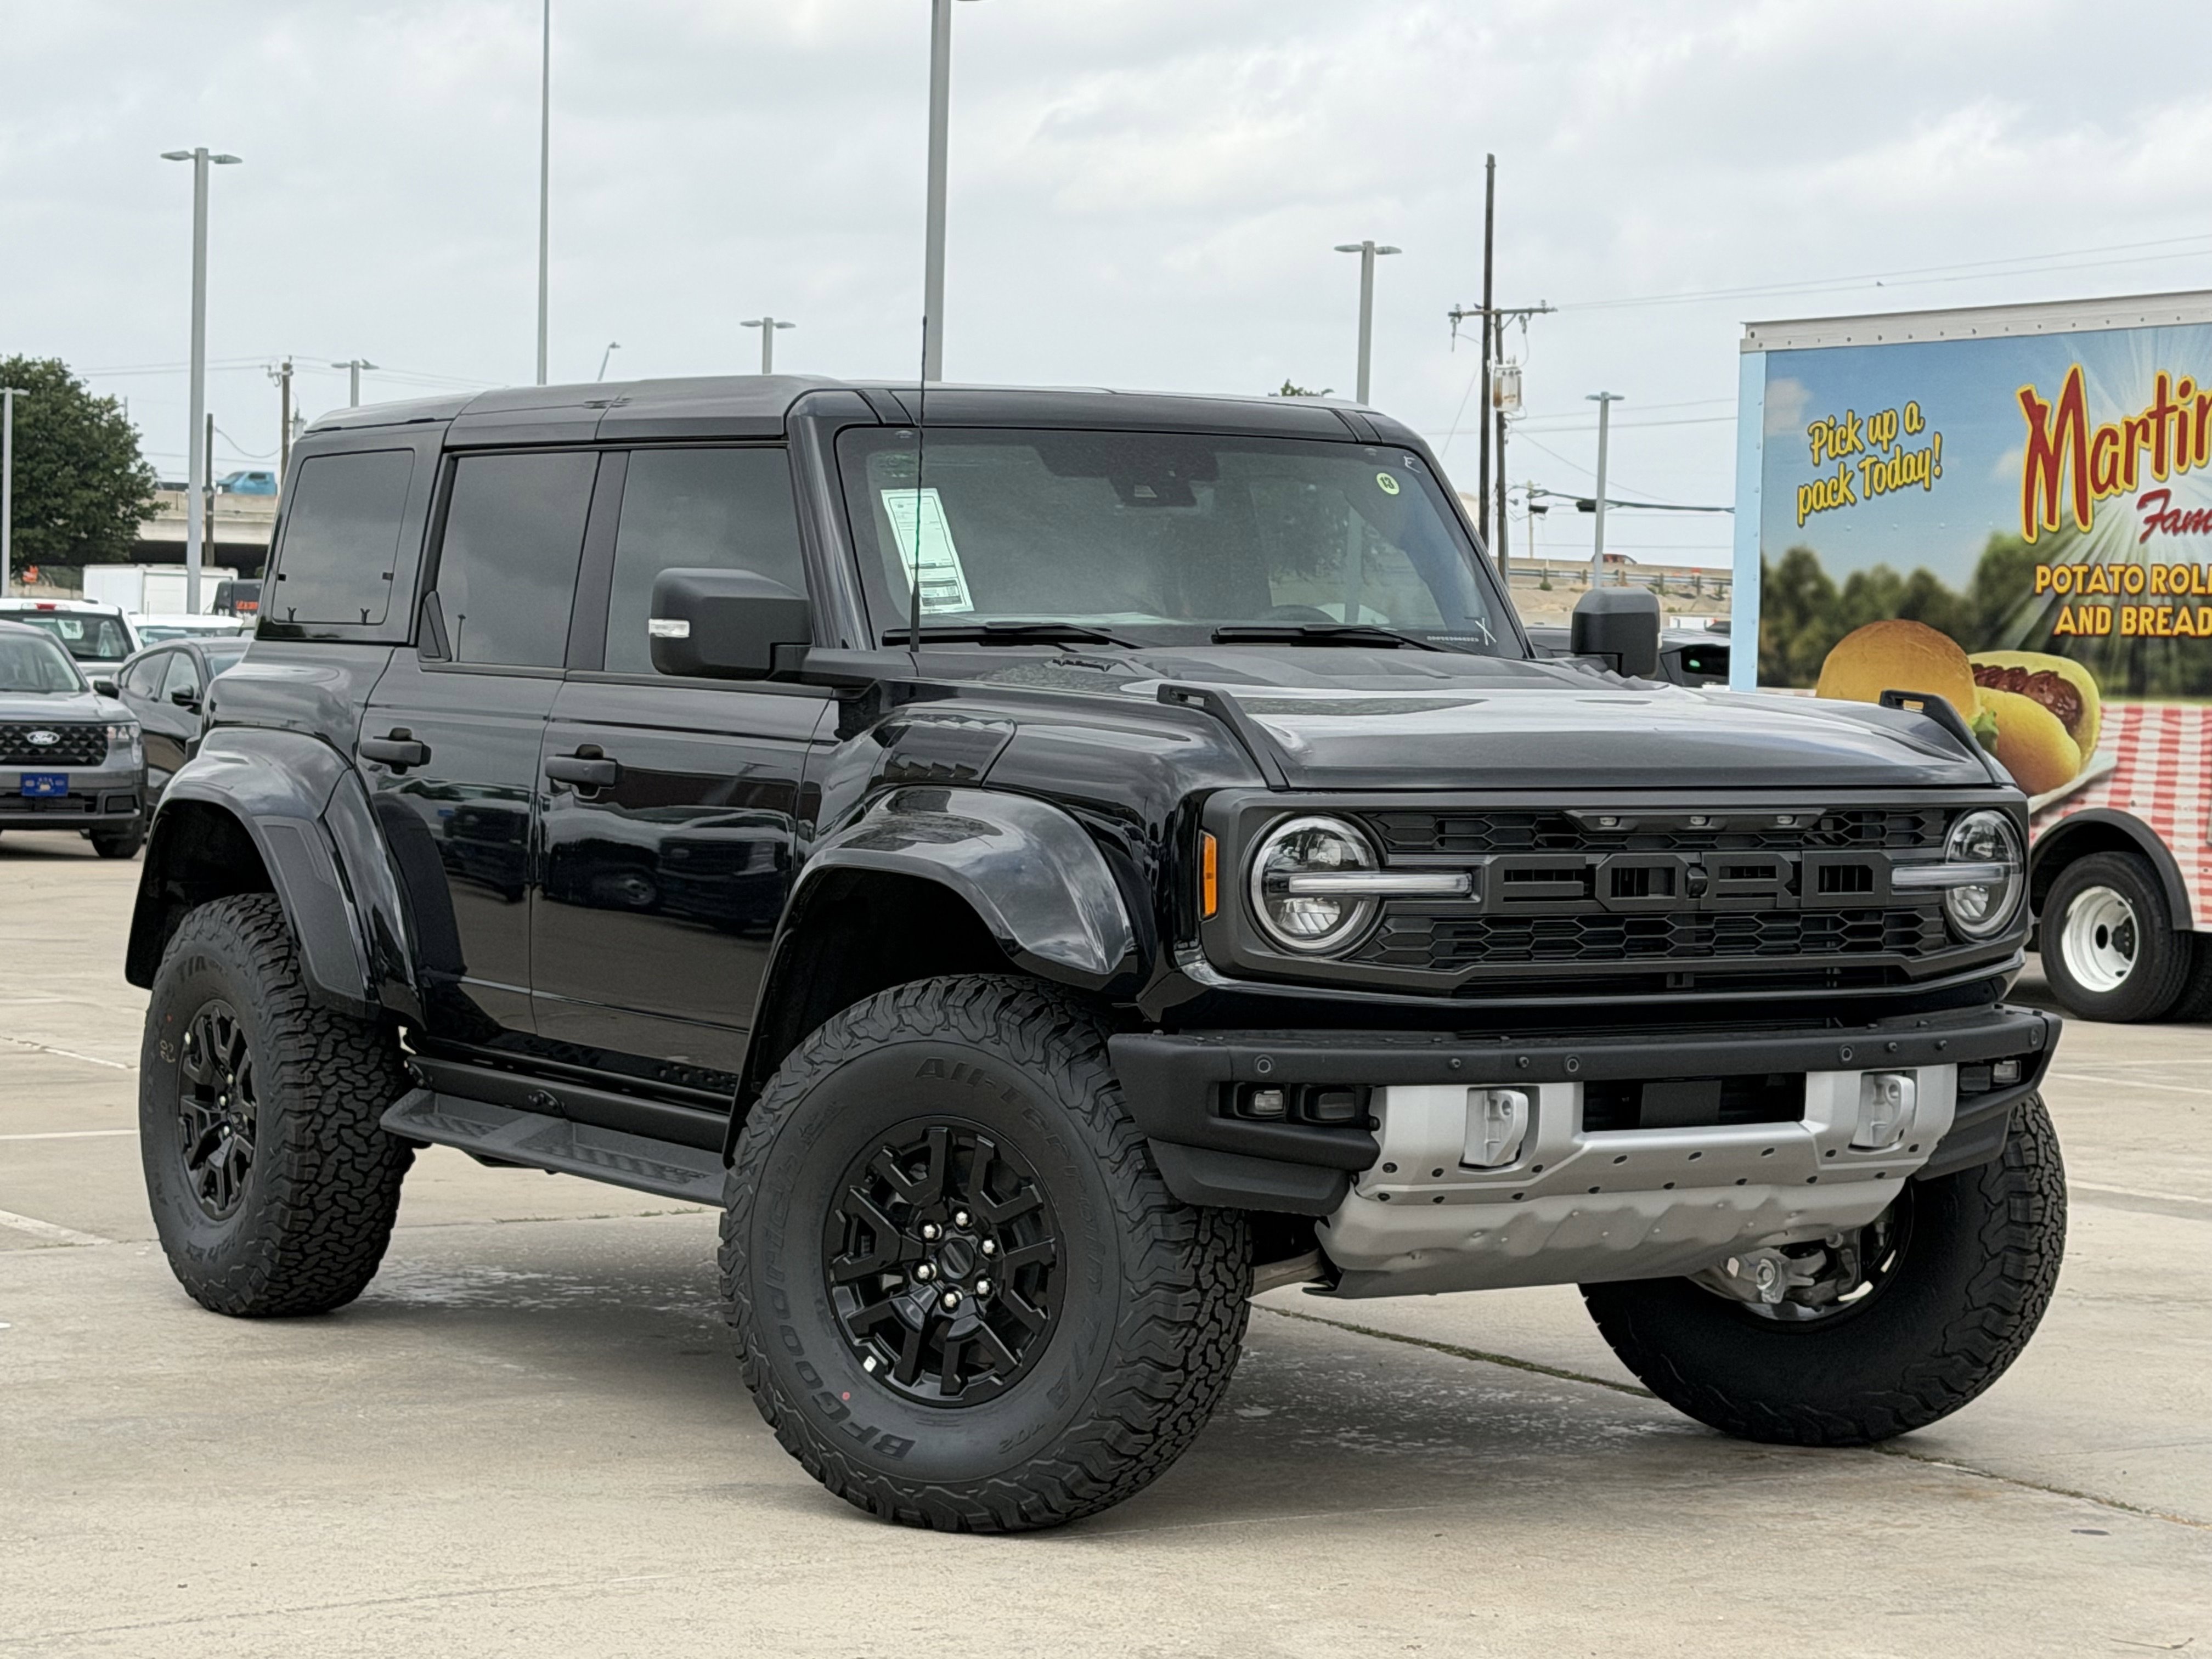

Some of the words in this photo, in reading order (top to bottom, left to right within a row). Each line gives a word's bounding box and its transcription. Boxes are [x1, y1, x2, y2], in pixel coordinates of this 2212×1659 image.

[1808, 409, 1865, 466] Pick
[1867, 409, 1898, 453] up
[1904, 401, 1926, 435] a
[1379, 476, 1395, 489] 13
[1797, 462, 1857, 528] pack
[1858, 431, 1943, 500] Today!
[2035, 563, 2145, 596] POTATO
[2053, 605, 2112, 636] AND
[2119, 605, 2212, 637] BREAD
[1487, 850, 1892, 913] FORD
[765, 1151, 916, 1460] BFGoodrich
